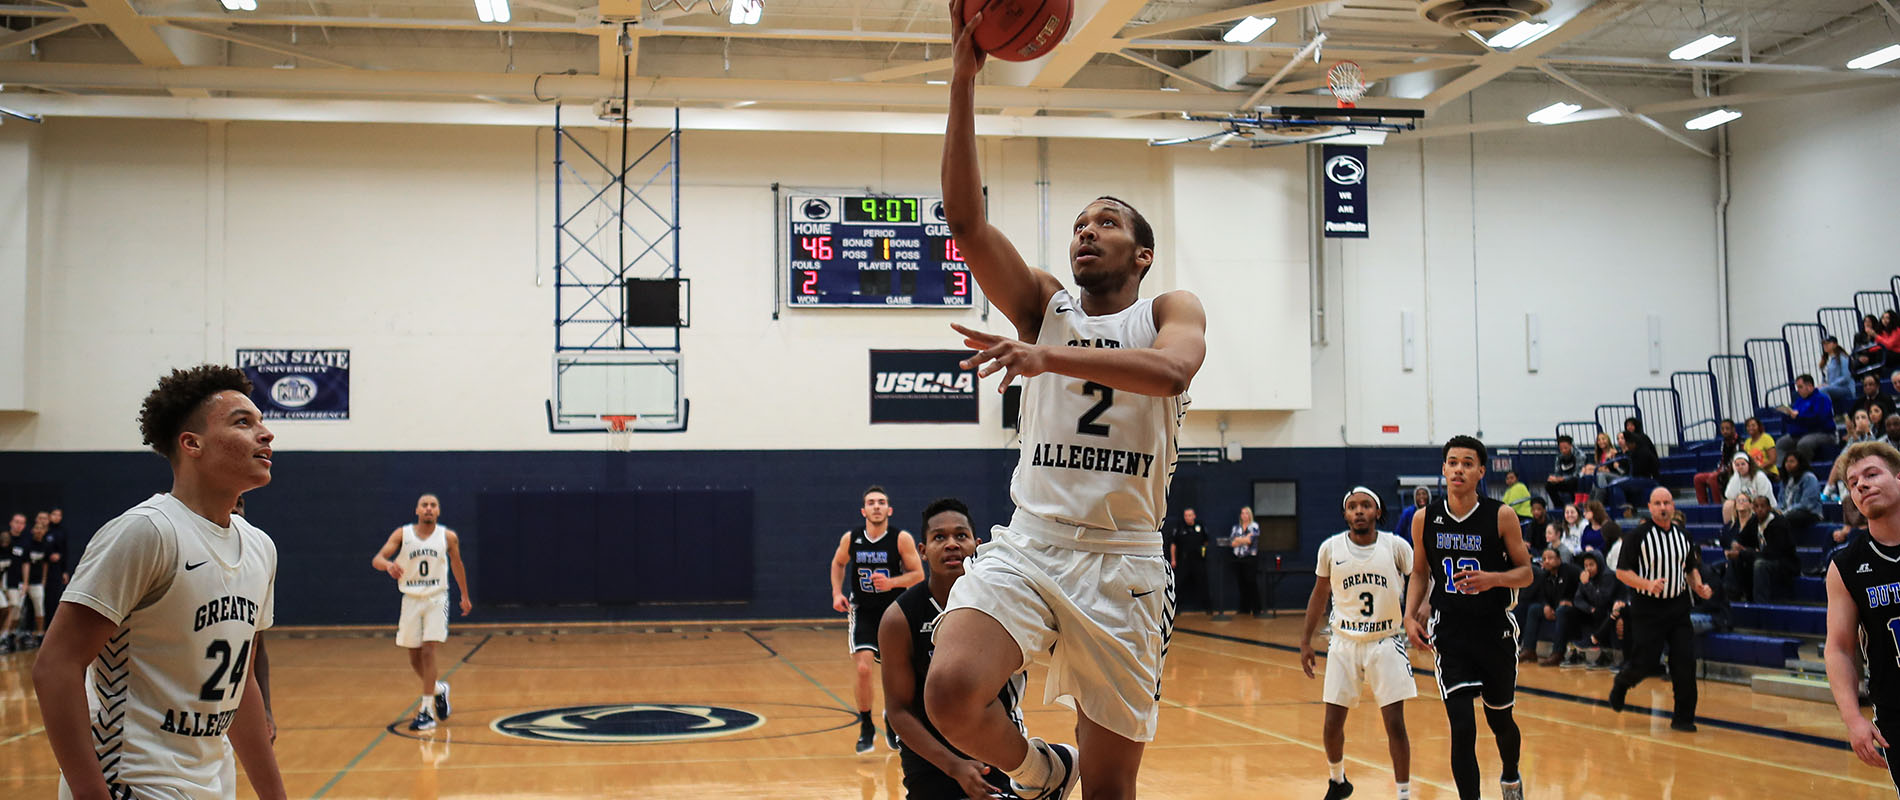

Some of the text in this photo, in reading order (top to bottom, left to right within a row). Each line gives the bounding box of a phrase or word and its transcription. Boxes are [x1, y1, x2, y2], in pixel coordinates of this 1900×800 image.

[861, 199, 917, 222] 9:07
[1338, 205, 1354, 213] ARE
[793, 223, 832, 235] HOME
[863, 229, 896, 238] PERIOD
[925, 224, 952, 237] GUE
[802, 236, 834, 260] 46
[842, 238, 874, 248] BONUS
[883, 238, 890, 261] 1
[889, 239, 920, 248] BONUS
[842, 250, 868, 260] POSS
[895, 251, 920, 260] POSS
[791, 261, 821, 270] FOULS
[858, 262, 920, 271] PLAYER FOUL
[802, 270, 818, 295] 2
[953, 271, 967, 296] 3
[797, 296, 819, 304] WON
[886, 296, 912, 305] GAME
[943, 297, 965, 305] WON
[239, 351, 348, 370] PENN STATE
[257, 365, 328, 373] UNIVERSITY
[875, 372, 974, 393] USCAA
[1076, 380, 1114, 437] 2
[1032, 443, 1154, 478] ALLEGHENY
[1436, 532, 1482, 551] BUTLER
[409, 548, 438, 560] GREATER
[856, 551, 888, 563] BUTLER
[419, 561, 429, 576] 0
[1342, 573, 1388, 590] GREATER
[1866, 582, 1900, 608] BUT
[1359, 592, 1374, 617] 3
[194, 596, 258, 632] GREATE
[1340, 619, 1393, 633] ALLEGHENY
[199, 639, 250, 702] 24
